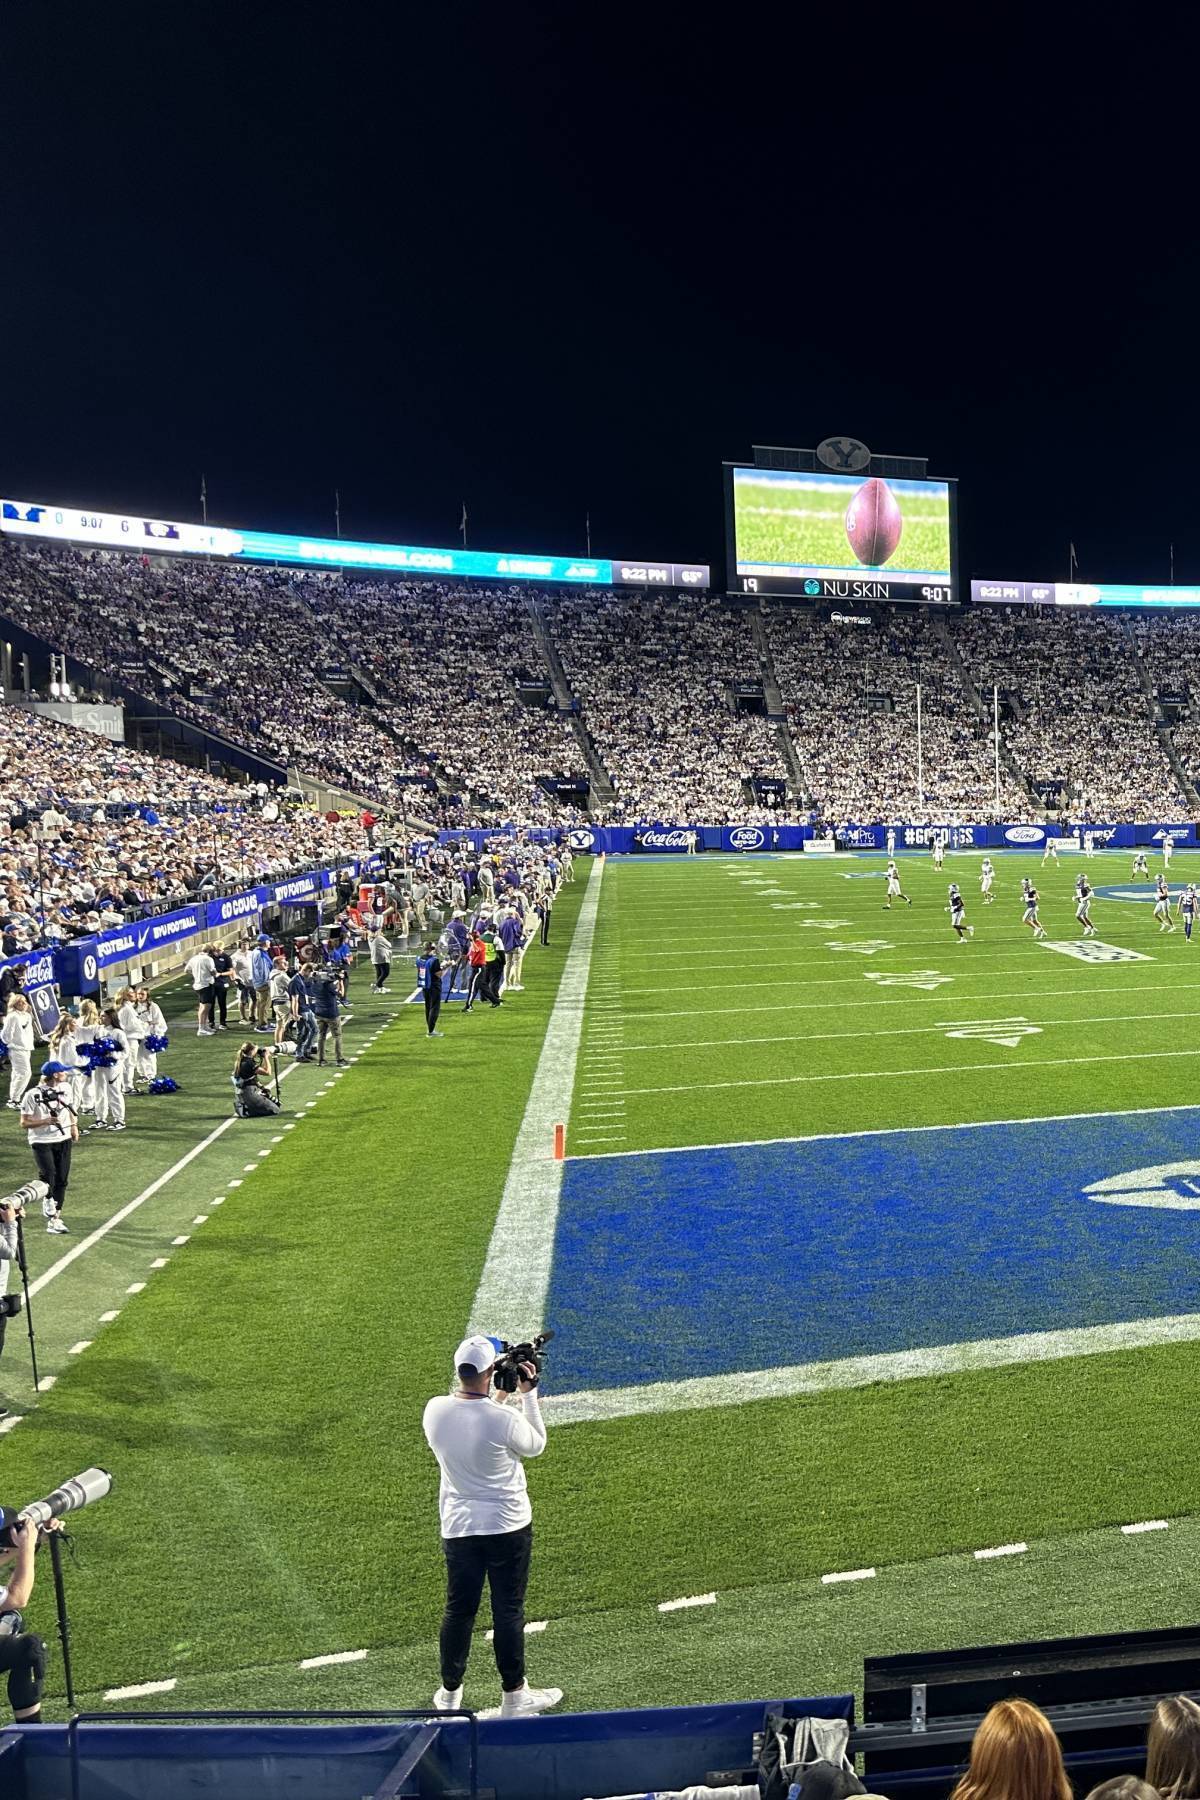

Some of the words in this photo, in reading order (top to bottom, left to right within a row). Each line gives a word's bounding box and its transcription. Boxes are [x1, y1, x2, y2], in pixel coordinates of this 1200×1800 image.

[80, 516, 103, 529] 9:07
[649, 569, 667, 581] PM
[743, 578, 758, 592] 19
[823, 581, 849, 597] NU
[853, 582, 889, 598] SKIN
[922, 586, 951, 601] 9:07
[1003, 588, 1019, 598] PM
[570, 833, 590, 846] Y
[1013, 829, 1036, 840] Ford
[288, 878, 314, 897] FOOTBALL
[1181, 895, 1192, 906] 35
[222, 903, 233, 919] GO
[167, 915, 196, 934] FOOTBALL
[934, 1016, 1044, 1039] 10
